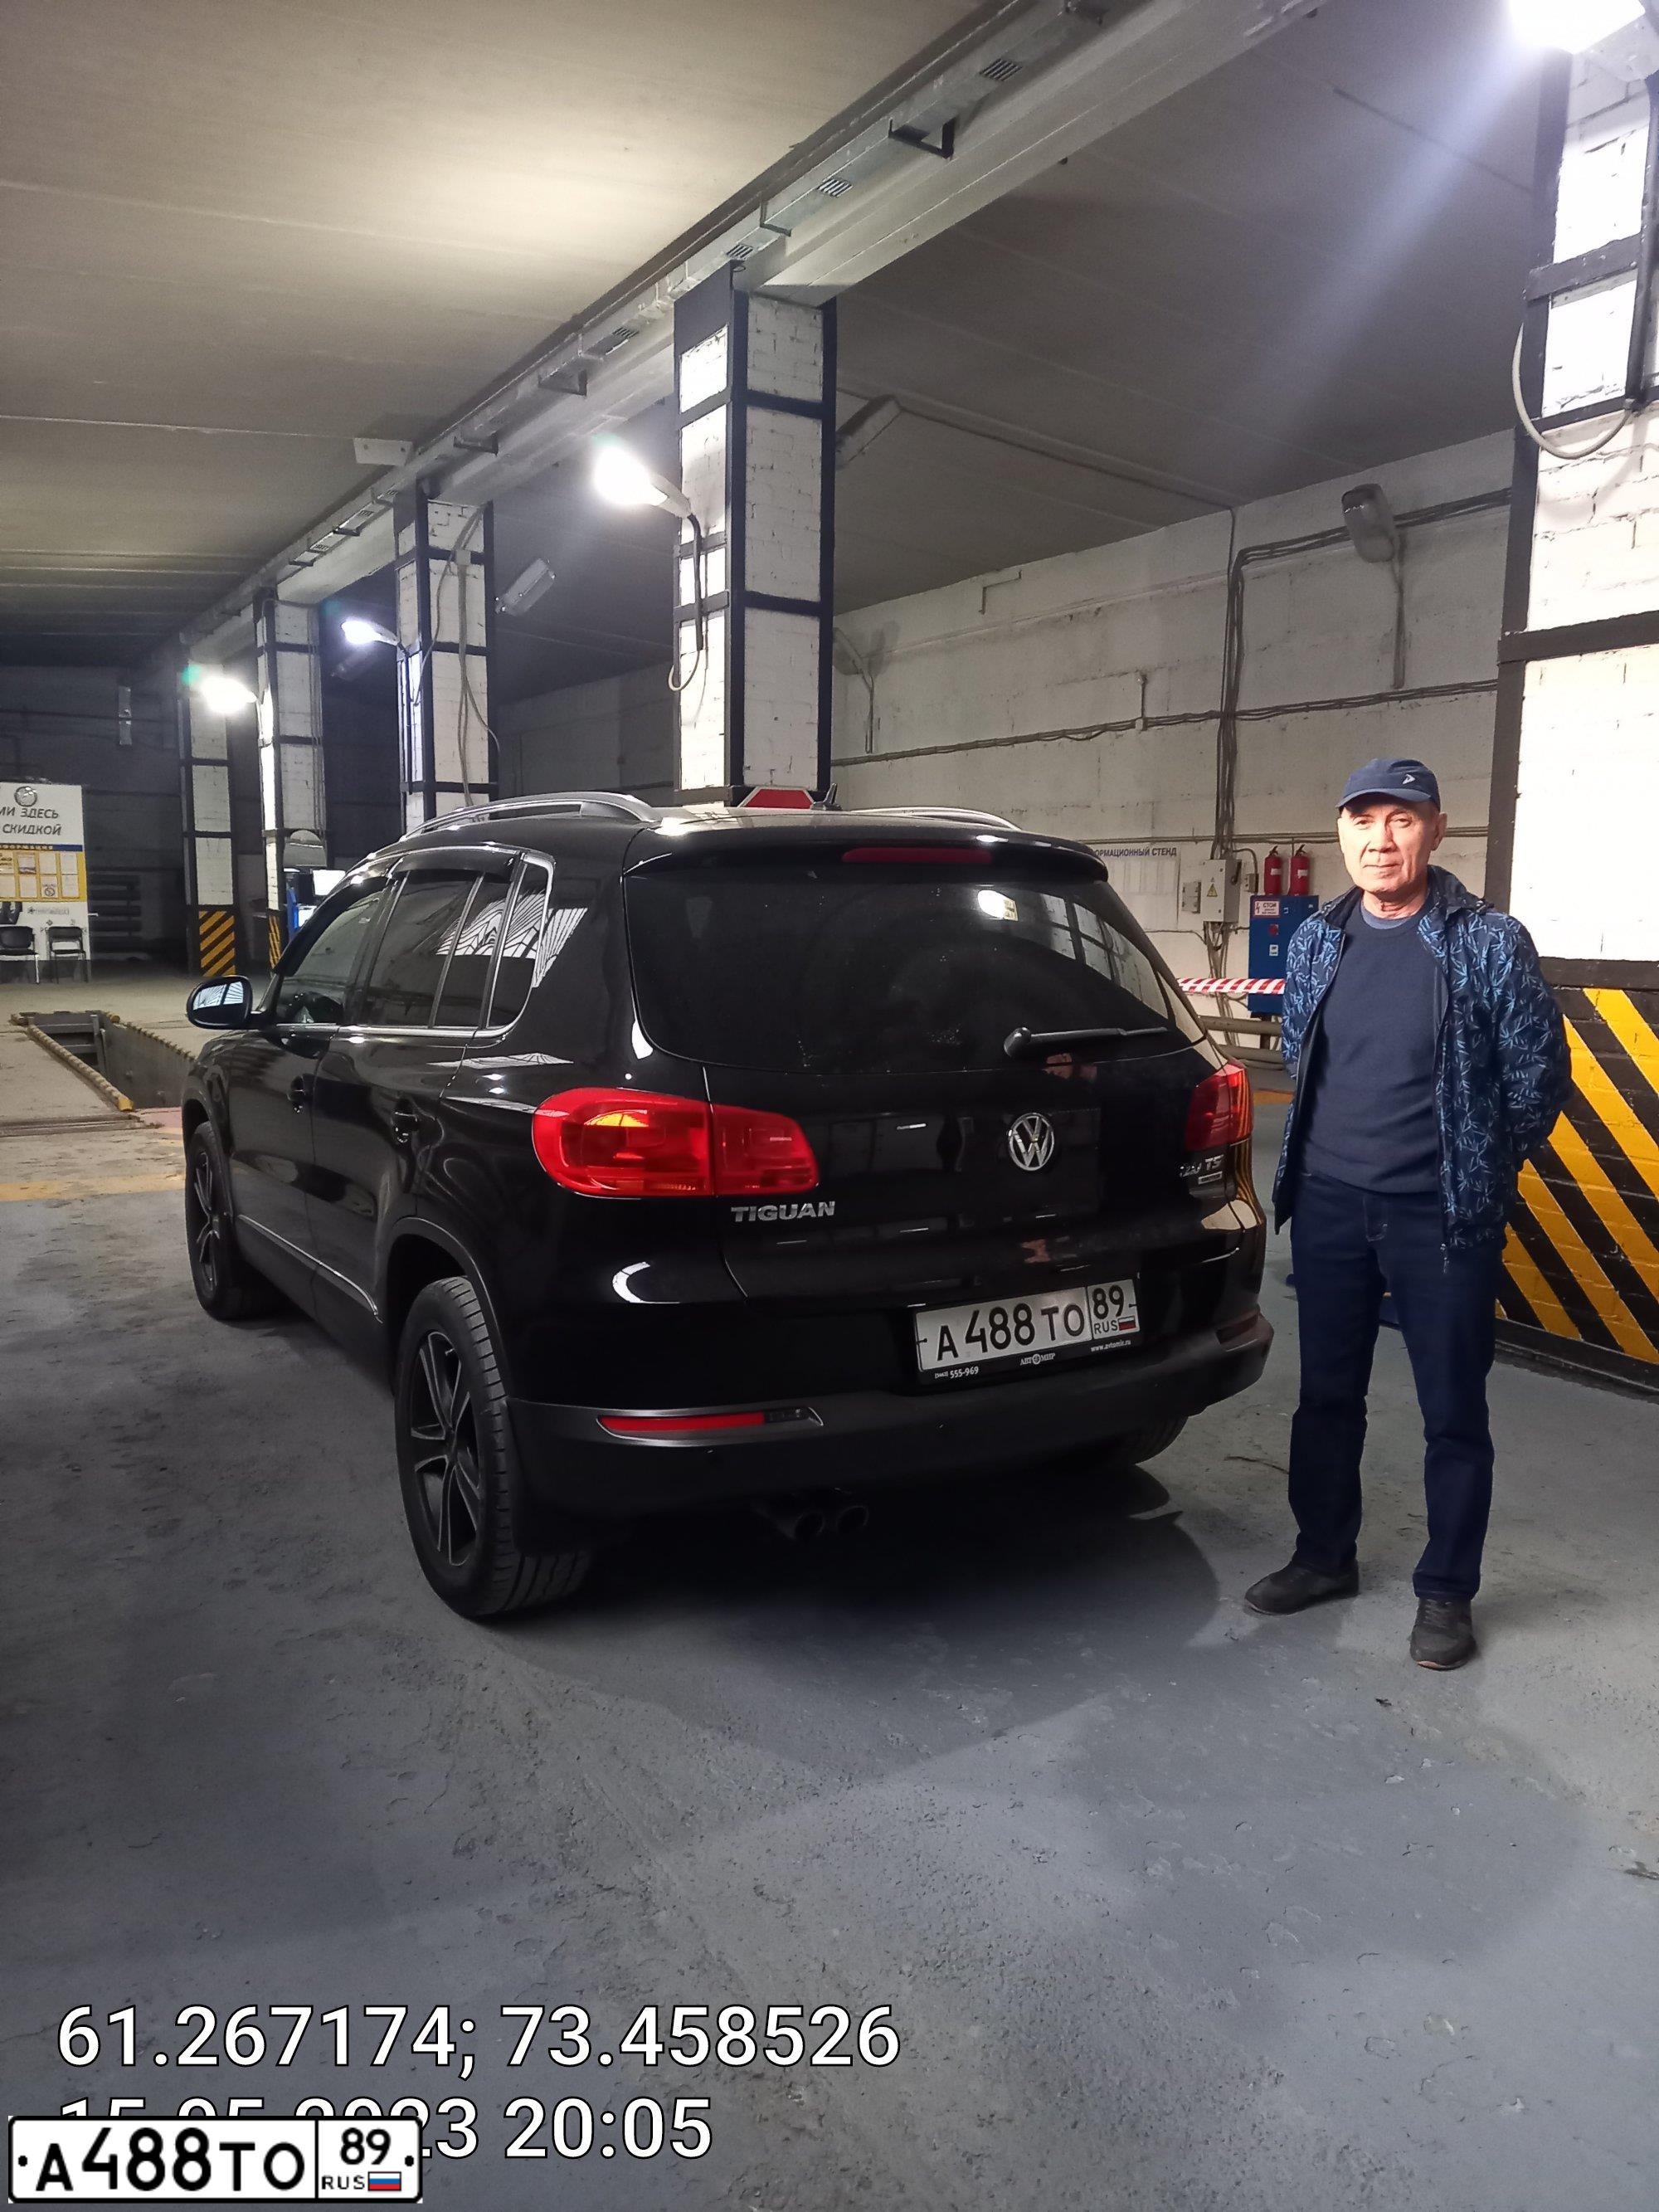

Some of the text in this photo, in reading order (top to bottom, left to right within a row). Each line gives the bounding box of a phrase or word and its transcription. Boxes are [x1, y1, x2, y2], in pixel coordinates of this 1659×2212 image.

[21, 807, 59, 819] ЗДЕСЬ
[2, 823, 62, 836] СКИДКОЙ
[1152, 846, 1177, 857] СТЕНД
[731, 1201, 836, 1222] TIGUAN
[1092, 1284, 1125, 1320] 89
[1094, 1318, 1118, 1334] RUS
[949, 1366, 980, 1379] 555-969
